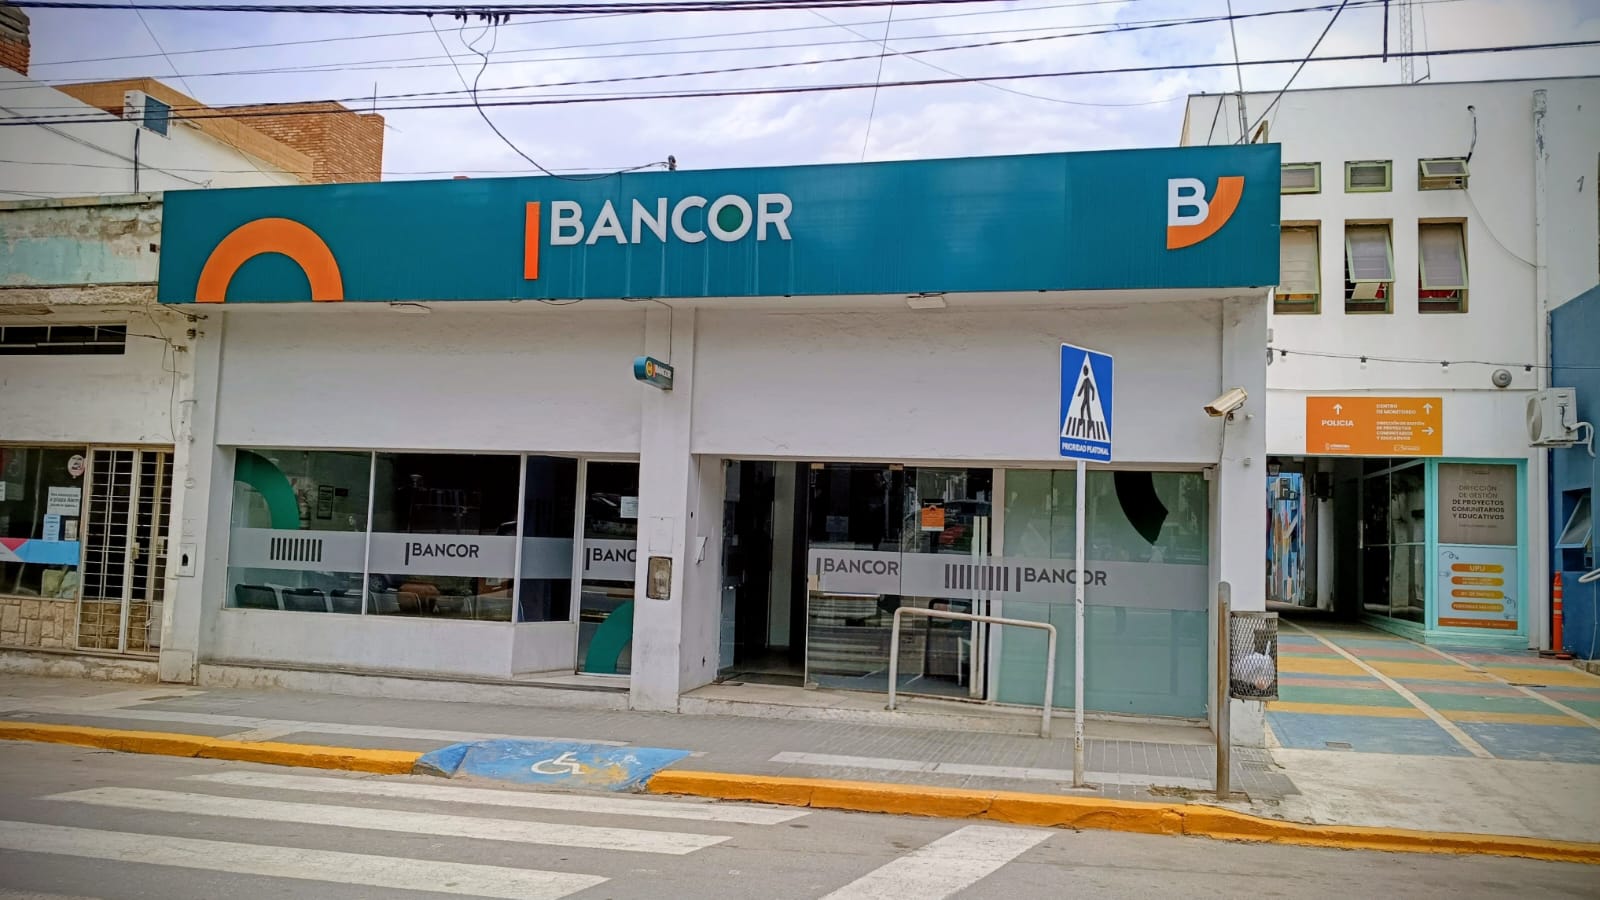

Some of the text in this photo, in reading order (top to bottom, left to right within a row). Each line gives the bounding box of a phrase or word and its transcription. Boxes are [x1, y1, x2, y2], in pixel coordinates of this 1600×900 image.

[550, 193, 793, 246] BANCOR
[1321, 418, 1354, 427] POLICIA
[1458, 484, 1497, 492] DIRECCIÓN
[412, 542, 480, 558] BANCOR
[823, 558, 899, 575] BANCOR
[1024, 567, 1107, 586] BANCOR
